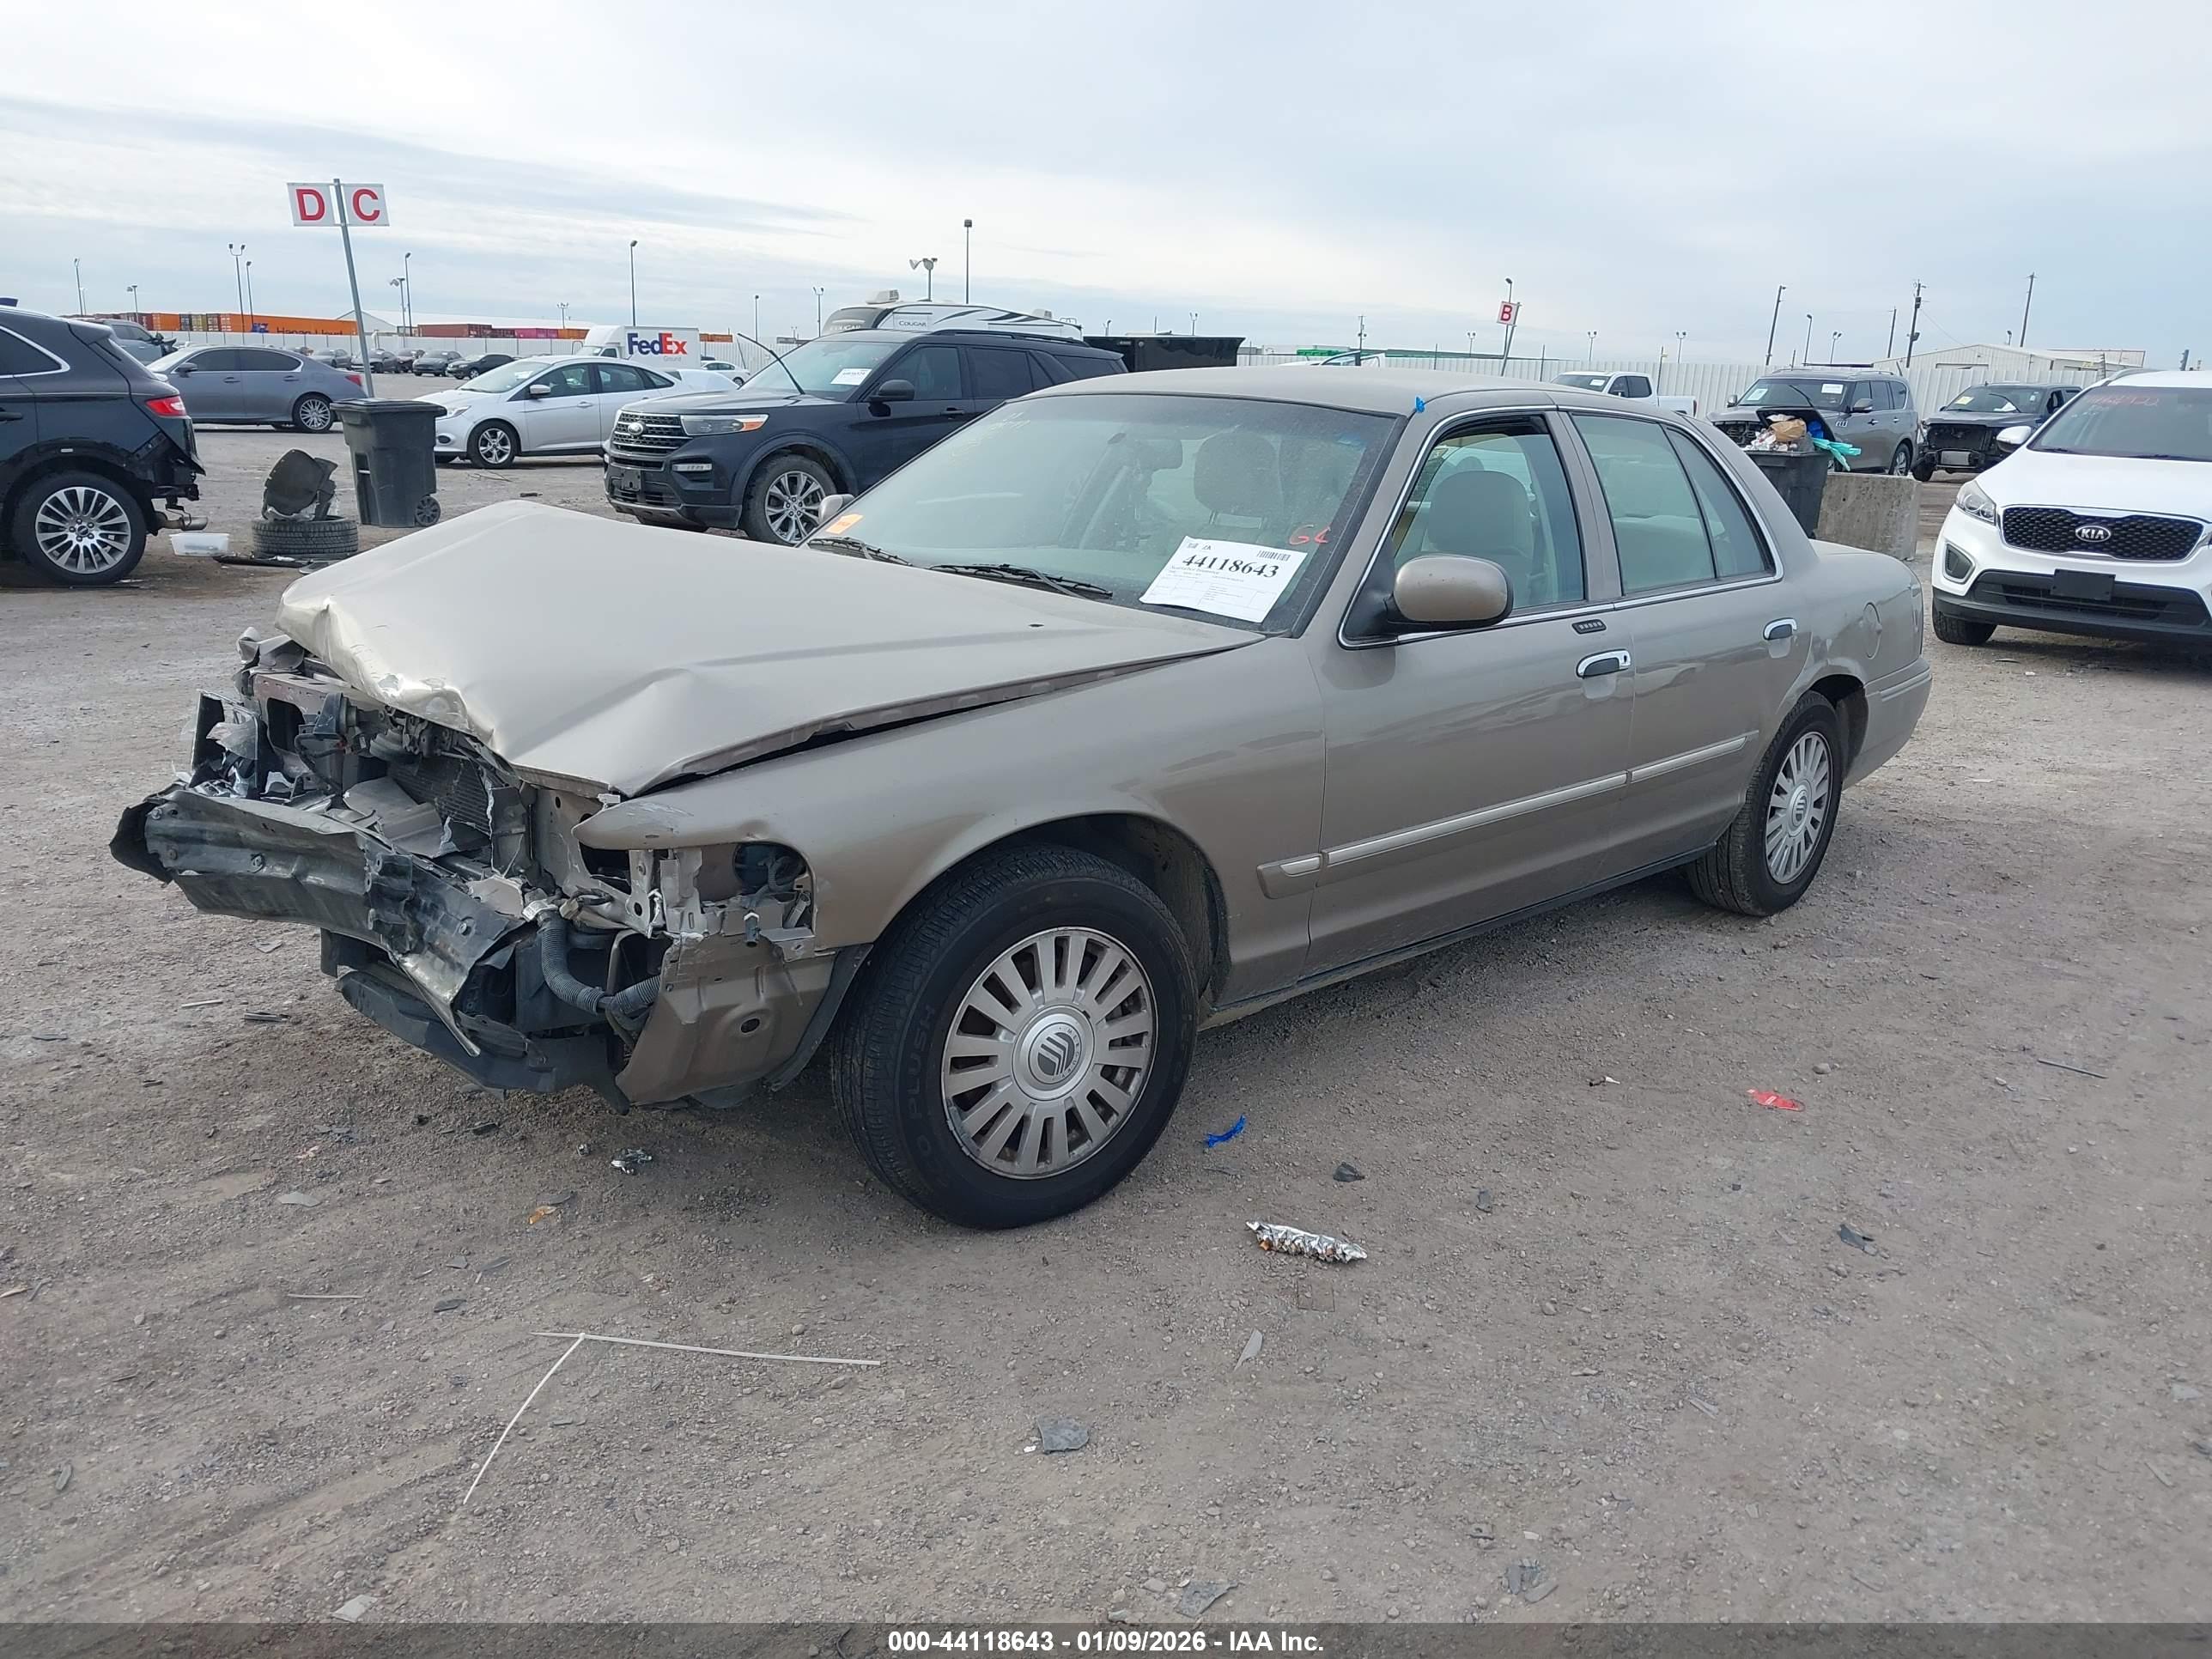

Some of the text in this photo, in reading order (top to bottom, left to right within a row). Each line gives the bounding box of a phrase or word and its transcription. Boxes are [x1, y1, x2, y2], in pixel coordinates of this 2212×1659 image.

[295, 189, 325, 221] D
[352, 189, 380, 222] C
[1500, 304, 1513, 321] B
[627, 333, 688, 355] FedEx
[2081, 528, 2105, 539] KIA
[1182, 554, 1279, 578] 44118643
